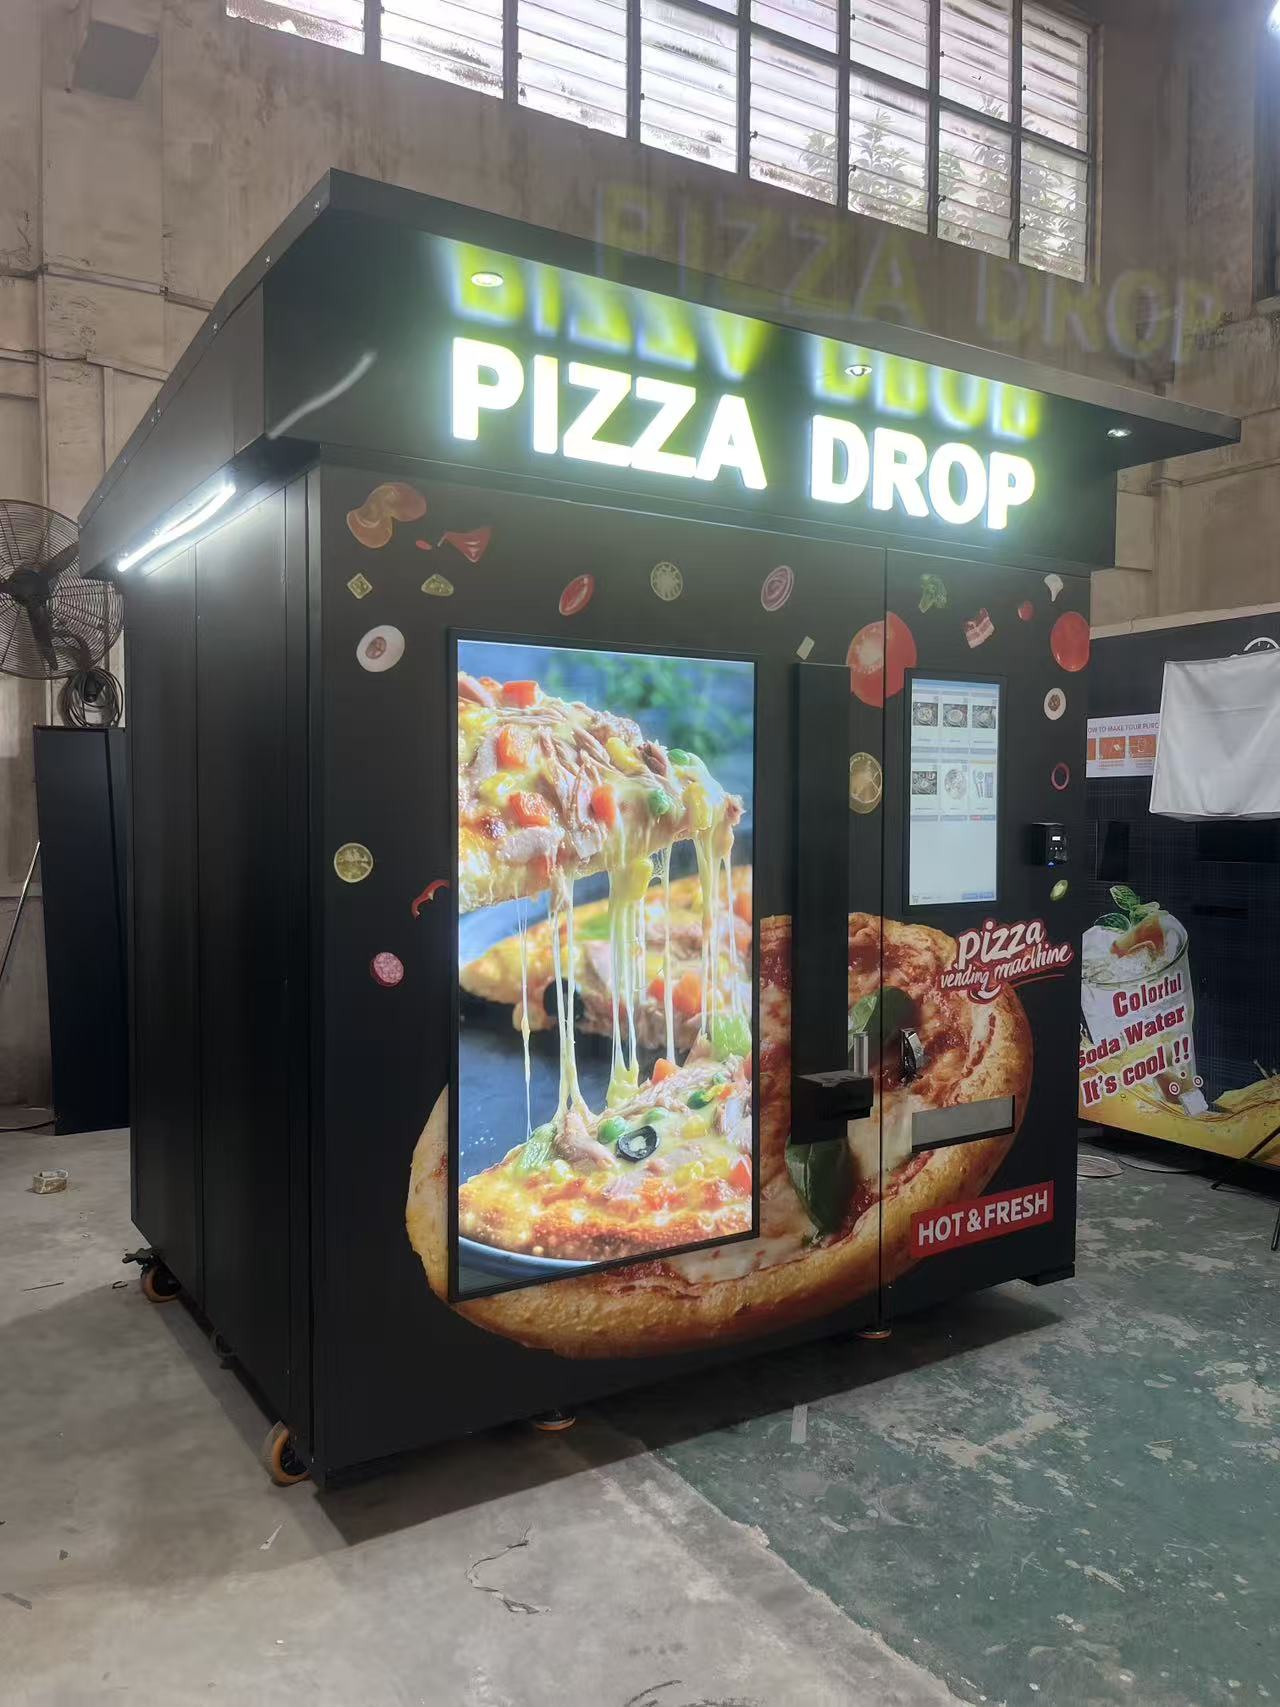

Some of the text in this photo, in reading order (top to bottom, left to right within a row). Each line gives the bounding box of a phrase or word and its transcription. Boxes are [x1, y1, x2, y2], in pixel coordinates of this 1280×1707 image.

[452, 336, 768, 490] PIZZA
[810, 413, 1036, 530] DROP
[940, 943, 1073, 992] vending machine
[957, 920, 1045, 970] pizza
[1113, 973, 1182, 1018] Colorful
[1124, 1005, 1185, 1046] Water
[1082, 1074, 1118, 1105] It's
[1122, 1045, 1166, 1087] cool
